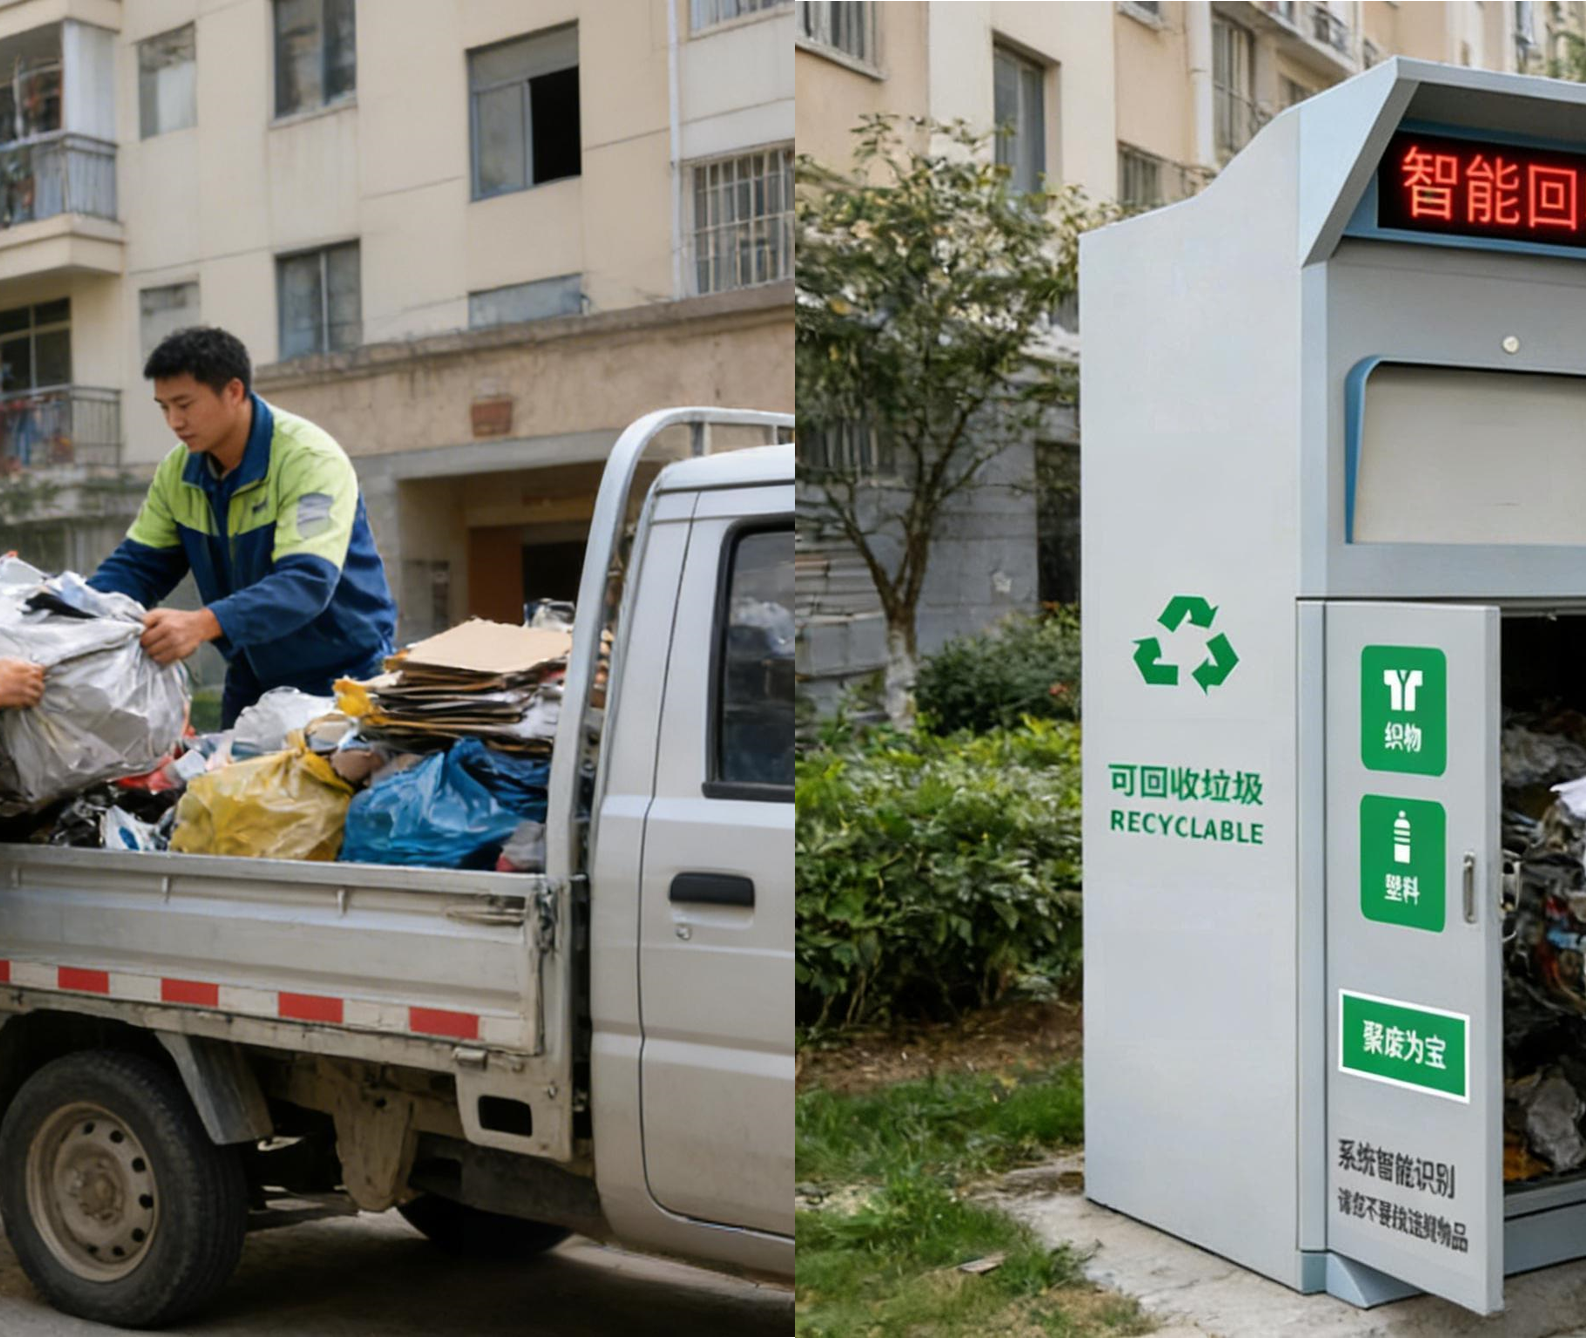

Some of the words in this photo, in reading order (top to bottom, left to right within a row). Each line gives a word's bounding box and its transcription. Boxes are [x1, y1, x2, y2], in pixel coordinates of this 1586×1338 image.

[1384, 721, 1422, 752] 织物
[1108, 764, 1264, 806] 可回收垃圾
[1110, 809, 1264, 845] RECYCLABLE
[1362, 1019, 1446, 1070] 聚废为宝
[1338, 1138, 1455, 1199] 系统智能识别
